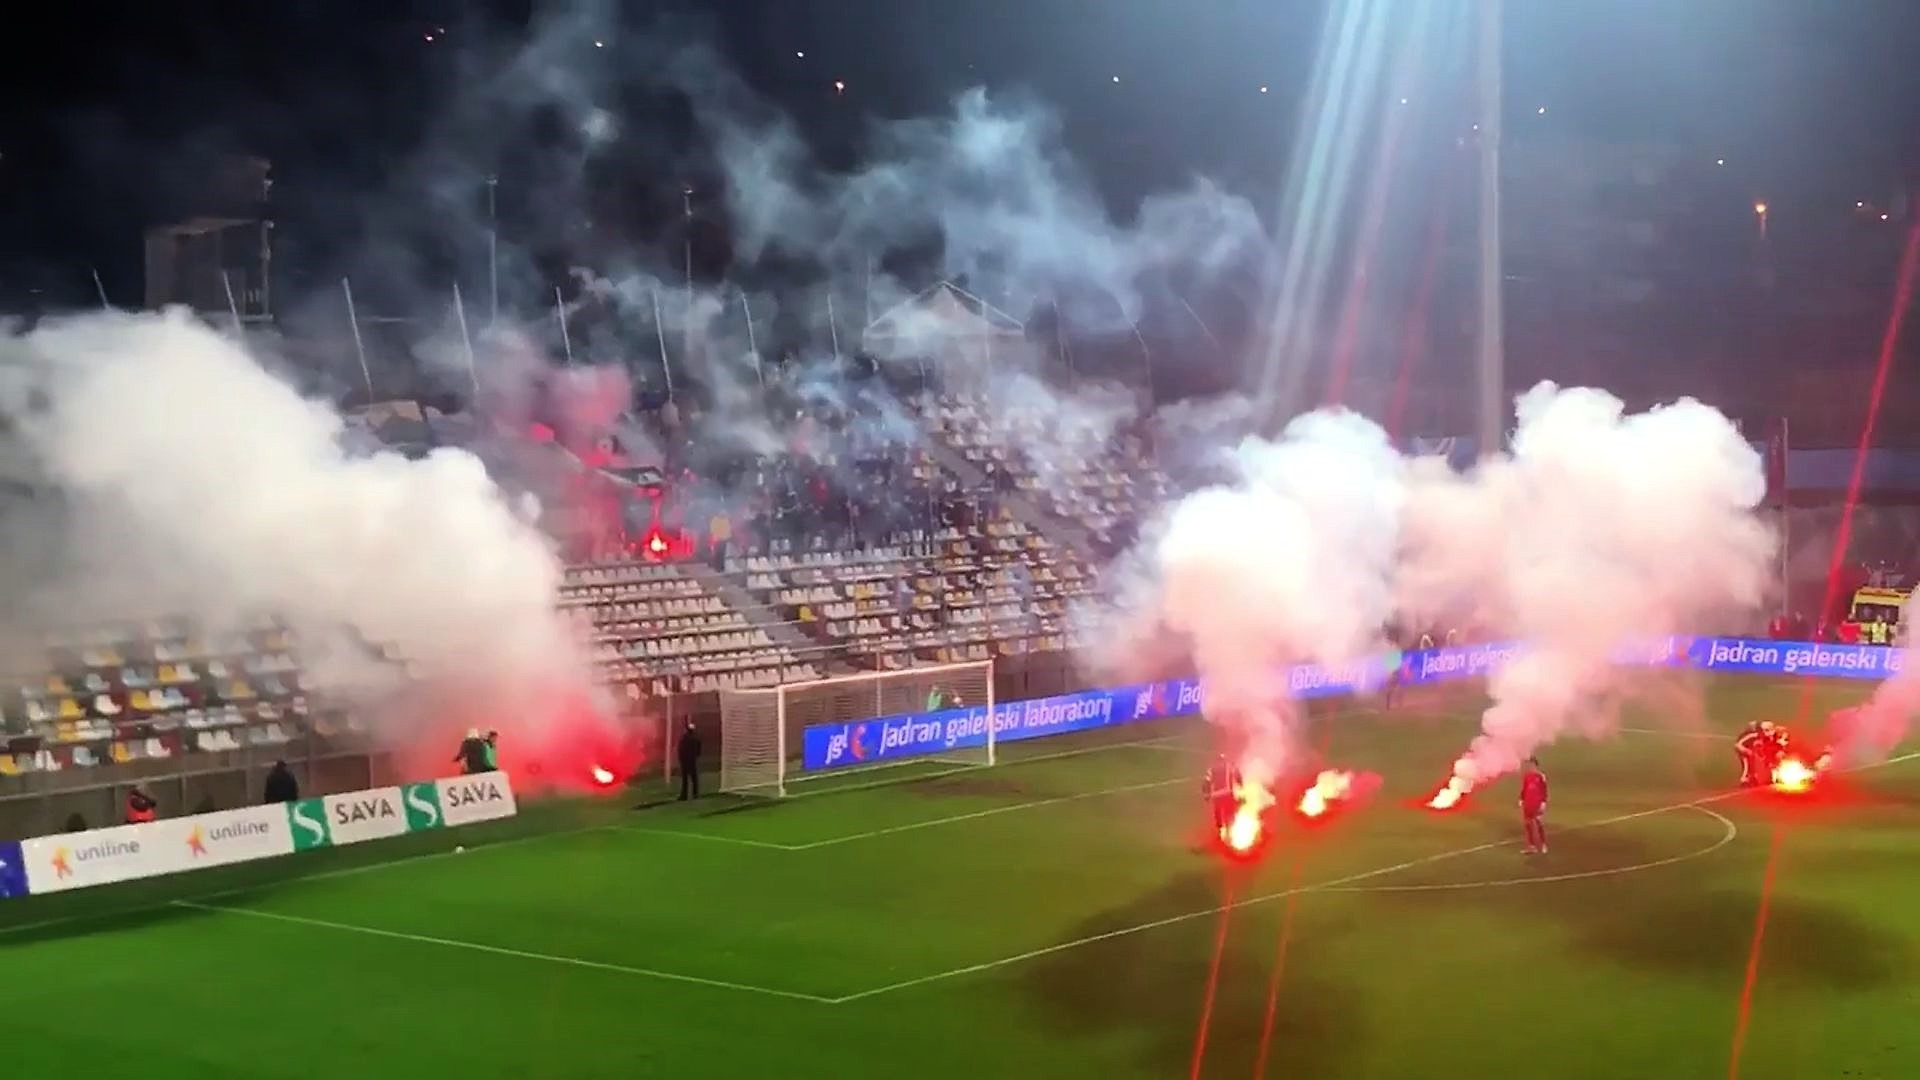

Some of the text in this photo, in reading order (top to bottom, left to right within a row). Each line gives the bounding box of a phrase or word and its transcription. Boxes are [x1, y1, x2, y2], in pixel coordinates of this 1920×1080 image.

[1707, 640, 1778, 667] Jadran
[1783, 643, 1877, 672] galenski
[825, 696, 1114, 765] jgl Jadran galenski laboratorij
[446, 782, 502, 808] SAVA
[335, 798, 396, 825] SAVA
[209, 820, 270, 841] uniline
[75, 839, 141, 861] uniline
